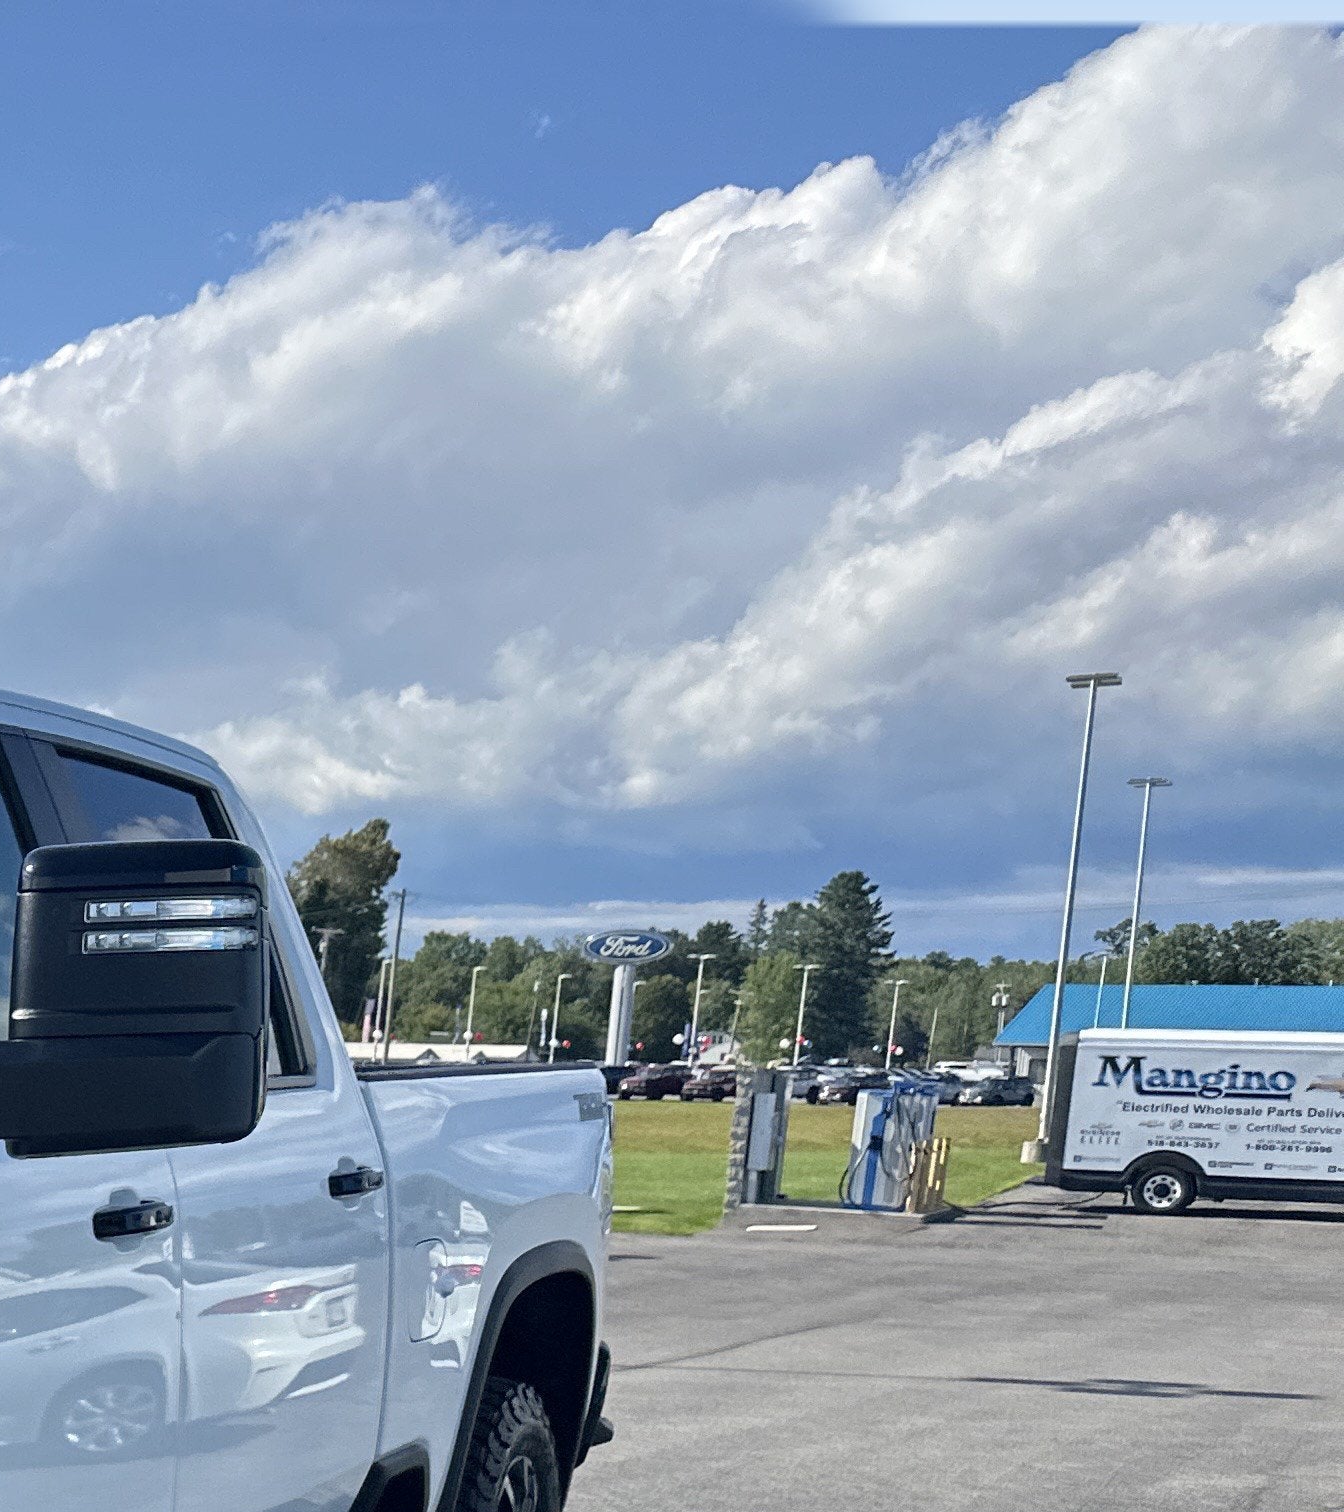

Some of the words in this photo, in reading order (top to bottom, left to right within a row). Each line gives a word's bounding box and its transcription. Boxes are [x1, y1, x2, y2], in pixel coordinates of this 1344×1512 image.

[599, 935, 653, 957] Ford
[1091, 1055, 1297, 1101] Mangino
[1193, 1104, 1263, 1117] Wholesale
[1267, 1106, 1303, 1118] Parts
[1246, 1122, 1297, 1134] Certified
[1300, 1124, 1343, 1135] Service
